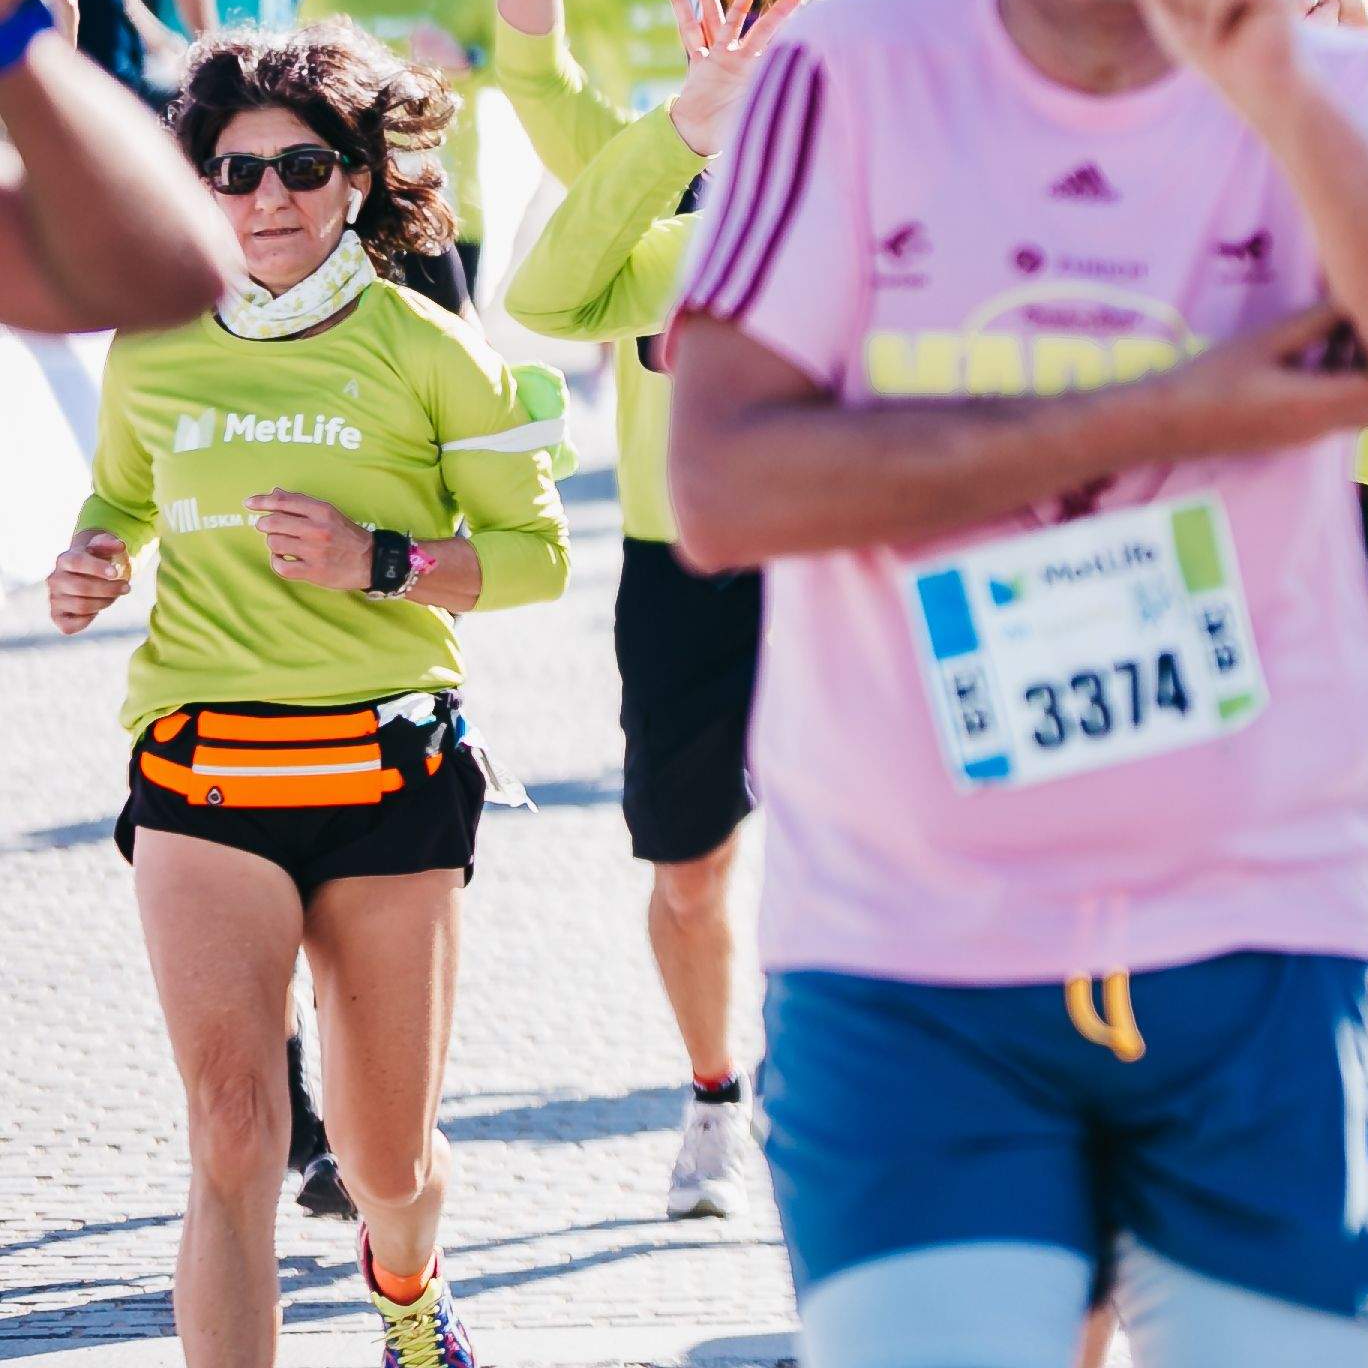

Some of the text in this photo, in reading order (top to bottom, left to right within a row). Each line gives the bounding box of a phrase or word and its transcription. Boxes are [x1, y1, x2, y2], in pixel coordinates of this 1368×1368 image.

[223, 412, 363, 450] MetLife
[162, 496, 199, 533] VIII
[202, 513, 244, 530] 15KM
[1024, 650, 1191, 749] 3374
